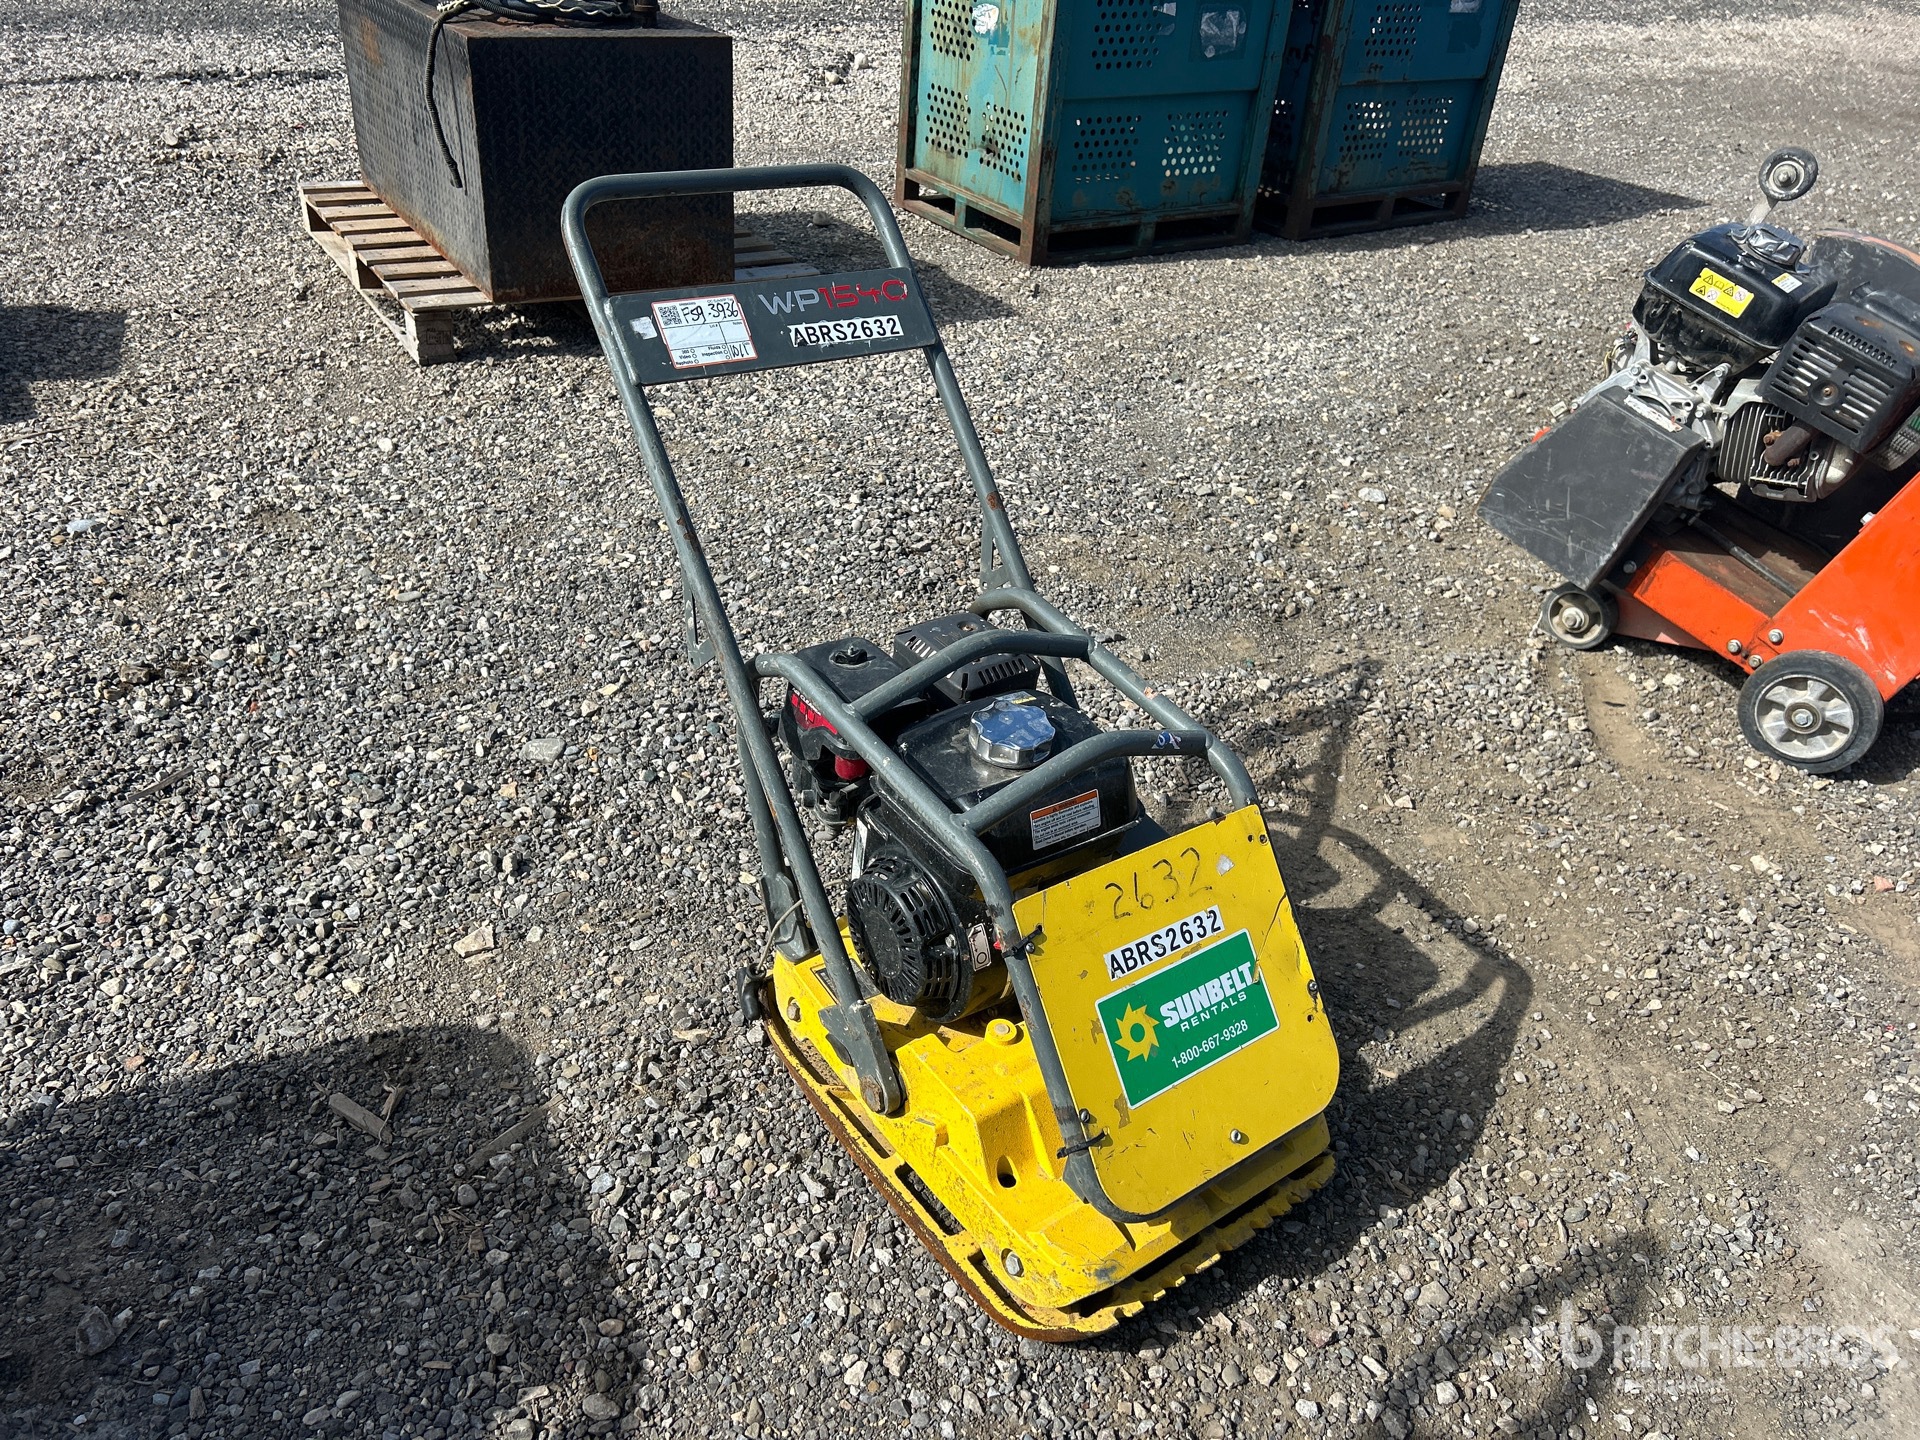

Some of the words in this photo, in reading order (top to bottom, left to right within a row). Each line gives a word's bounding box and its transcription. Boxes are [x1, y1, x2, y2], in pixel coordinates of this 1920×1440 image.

[758, 279, 908, 315] WP1540
[794, 318, 900, 346] ABRS2632
[1105, 847, 1212, 919] 2632
[1110, 909, 1221, 979] ABRS2632
[1160, 962, 1254, 1028] SUNBELT
[1180, 991, 1247, 1032] RENTALS
[1172, 1020, 1248, 1069] 1-800-667-9328
